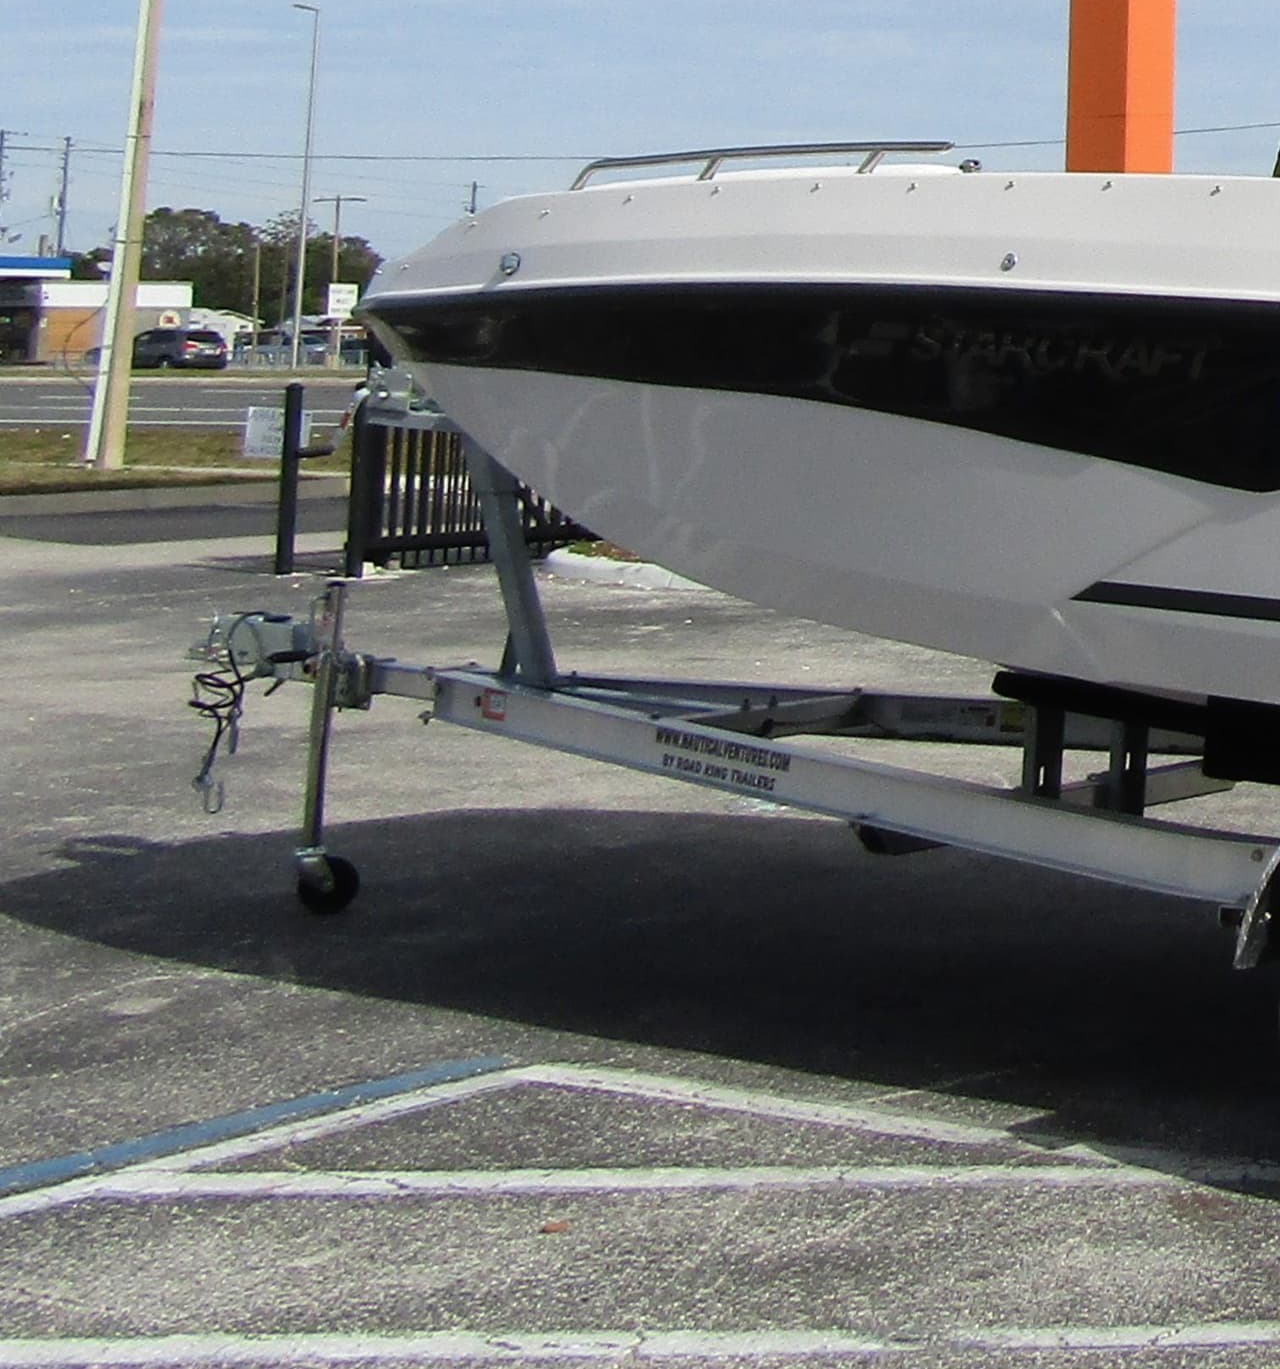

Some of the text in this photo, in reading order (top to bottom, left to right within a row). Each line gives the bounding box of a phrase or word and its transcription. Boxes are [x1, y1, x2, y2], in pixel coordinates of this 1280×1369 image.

[662, 753, 675, 768] BY
[676, 755, 703, 774] ROAD
[731, 768, 777, 791] TRAILERS
